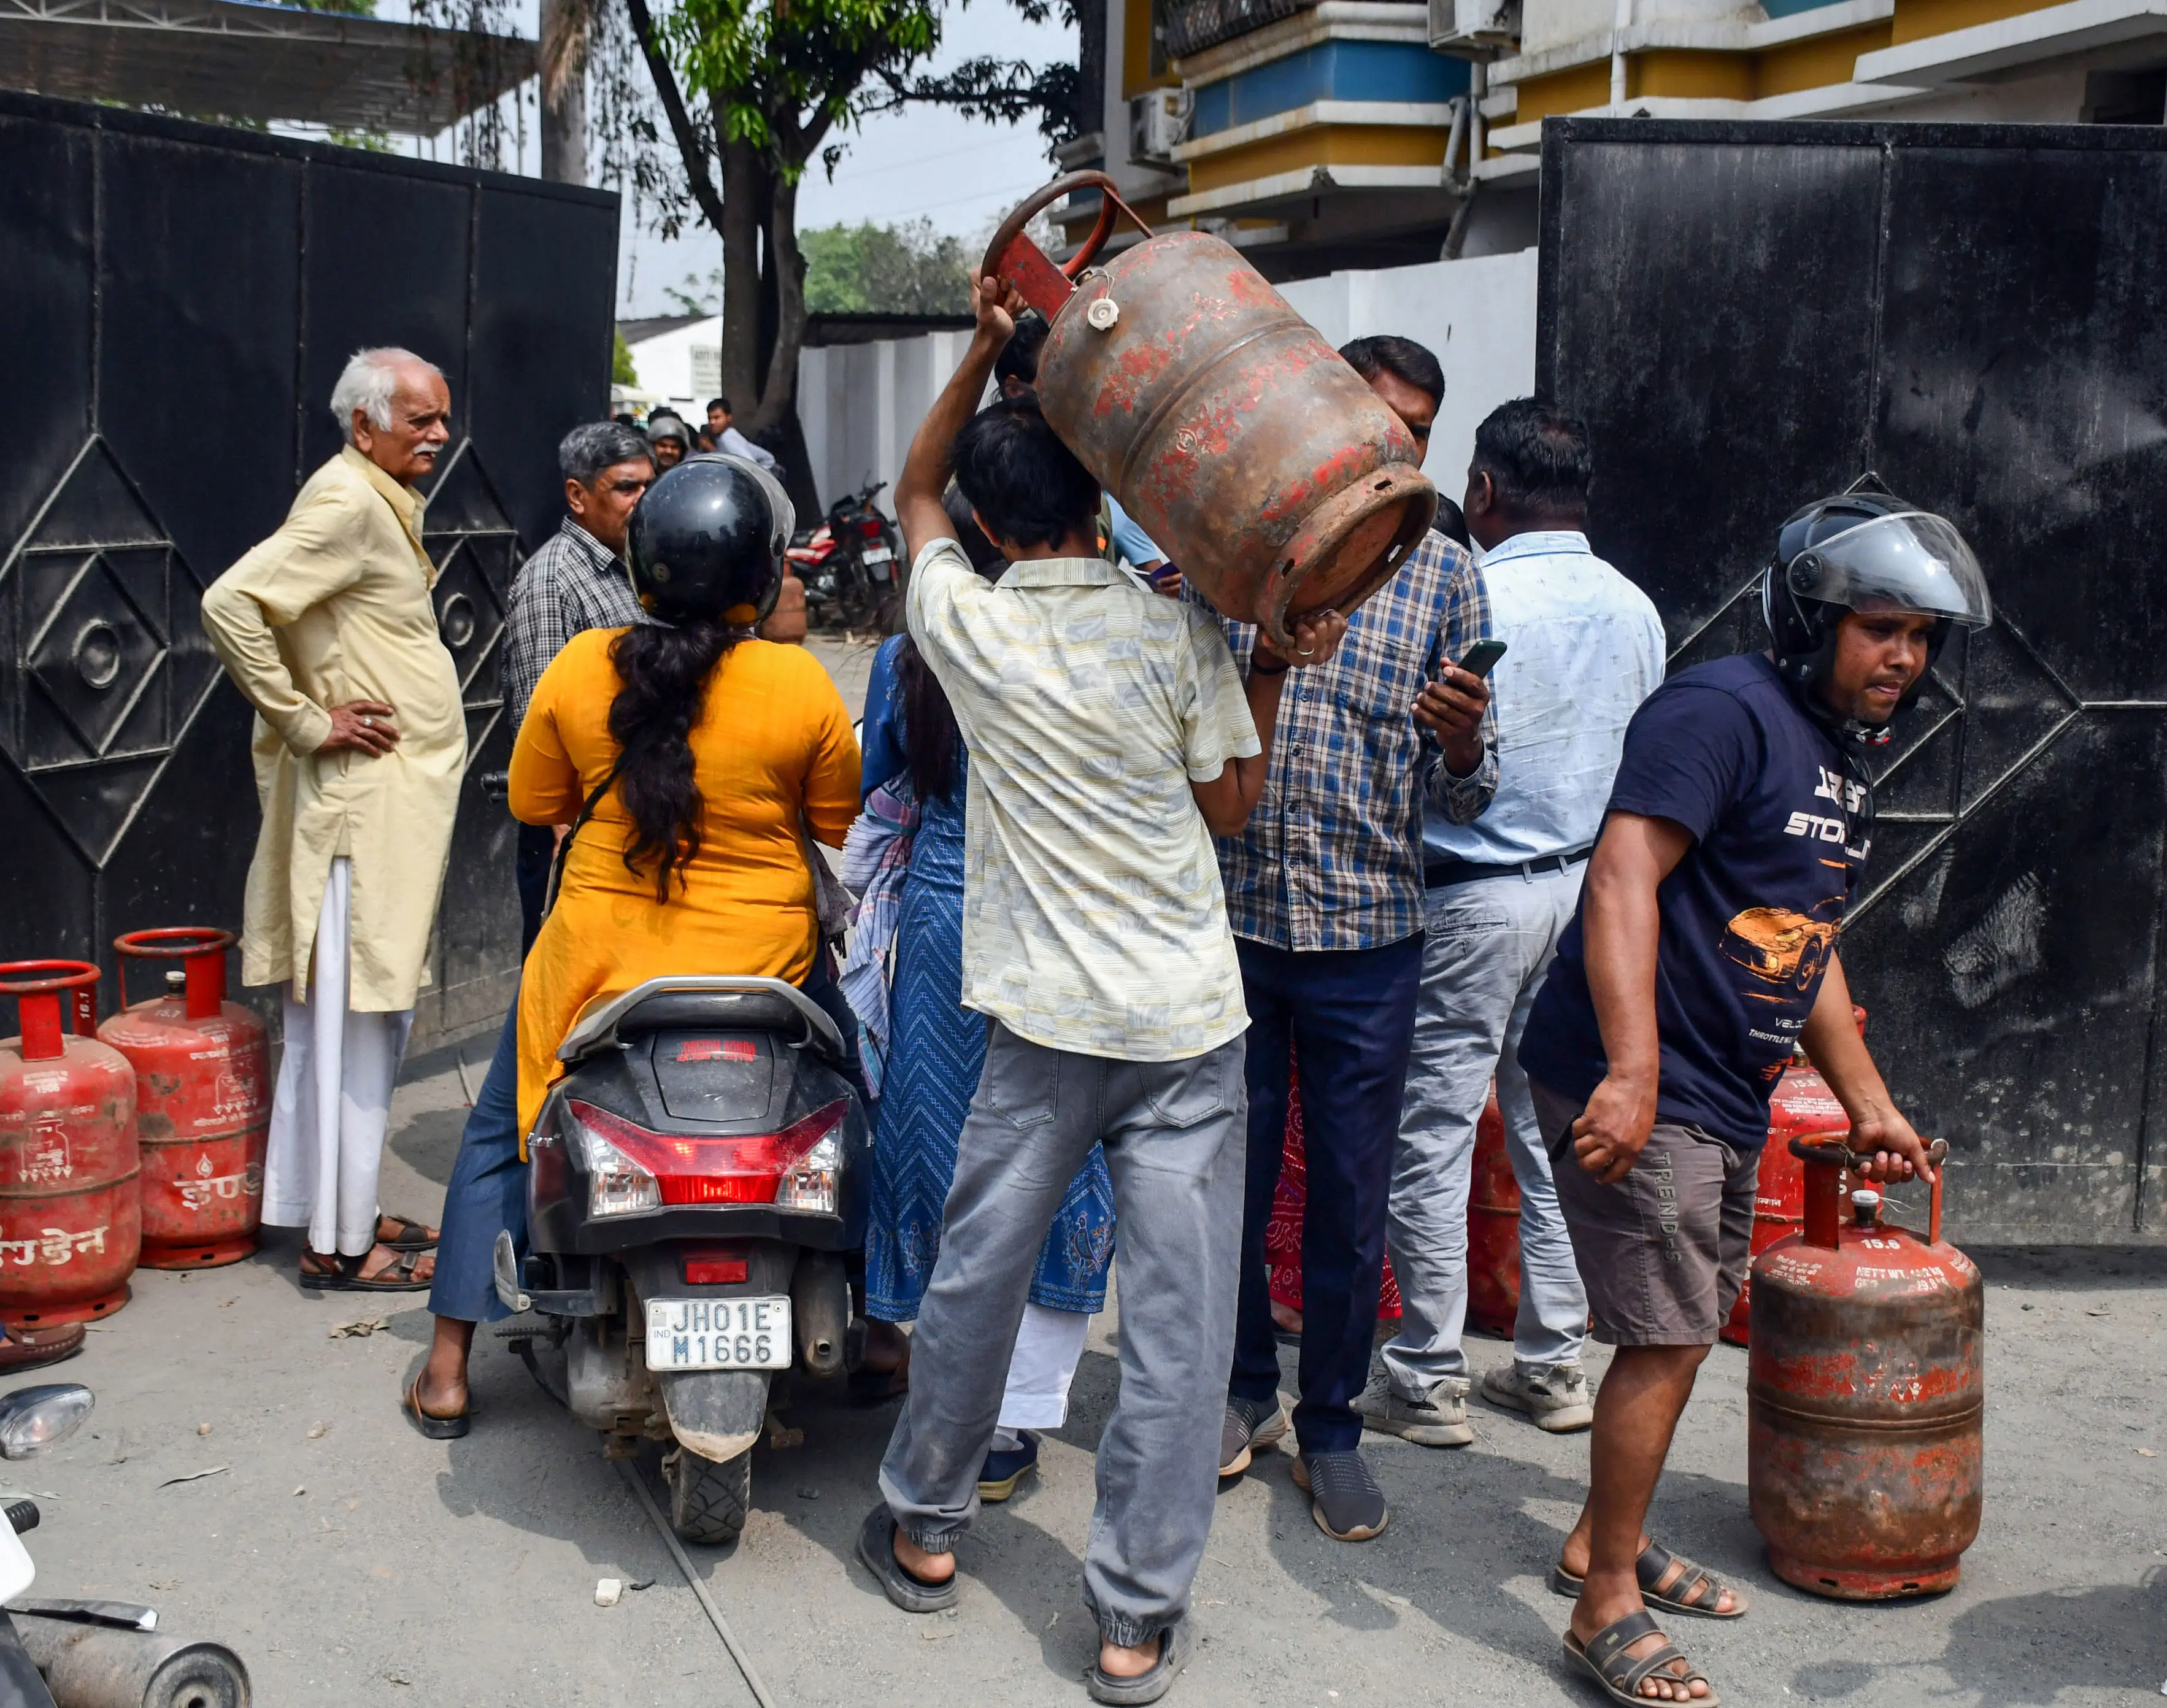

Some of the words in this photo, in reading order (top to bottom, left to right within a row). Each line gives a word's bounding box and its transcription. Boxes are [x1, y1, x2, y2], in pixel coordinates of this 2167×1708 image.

[1650, 1152, 1682, 1263] TREND-S
[1861, 1238, 1901, 1250] 15.6
[674, 1302, 771, 1332] JH01E
[653, 1329, 671, 1339] IND
[674, 1334, 771, 1364] M1666
